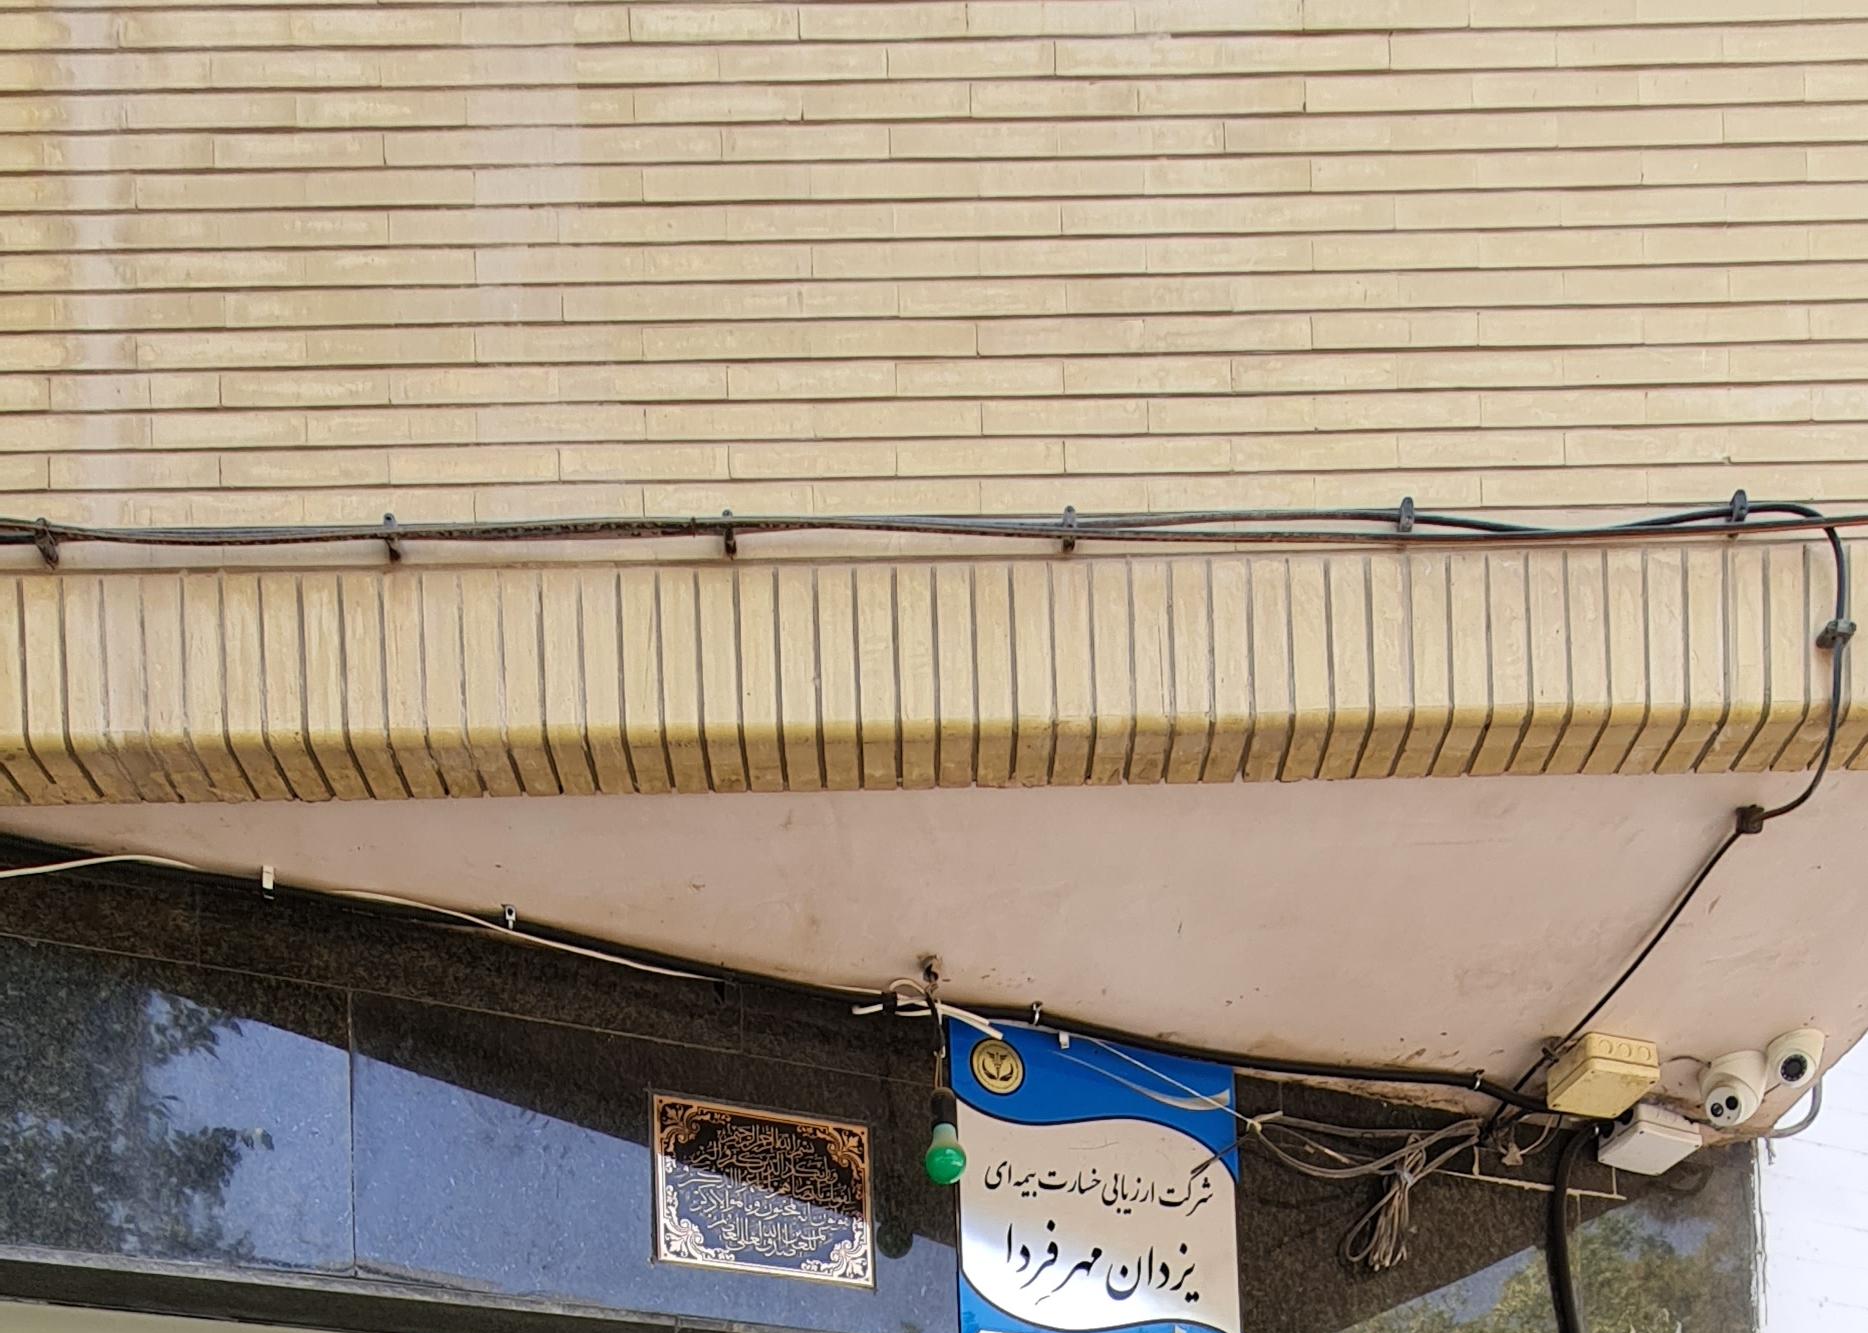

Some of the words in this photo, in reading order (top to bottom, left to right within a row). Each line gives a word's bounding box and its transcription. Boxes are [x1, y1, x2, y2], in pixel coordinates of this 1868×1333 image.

[1038, 1168, 1101, 1195] خسارت
[1101, 1173, 1155, 1214] ارزیابی
[1159, 1163, 1214, 1216] شرکت
[1007, 1219, 1059, 1290] فردا
[1048, 1247, 1103, 1296] مهر
[1106, 1243, 1200, 1303] یزدان
